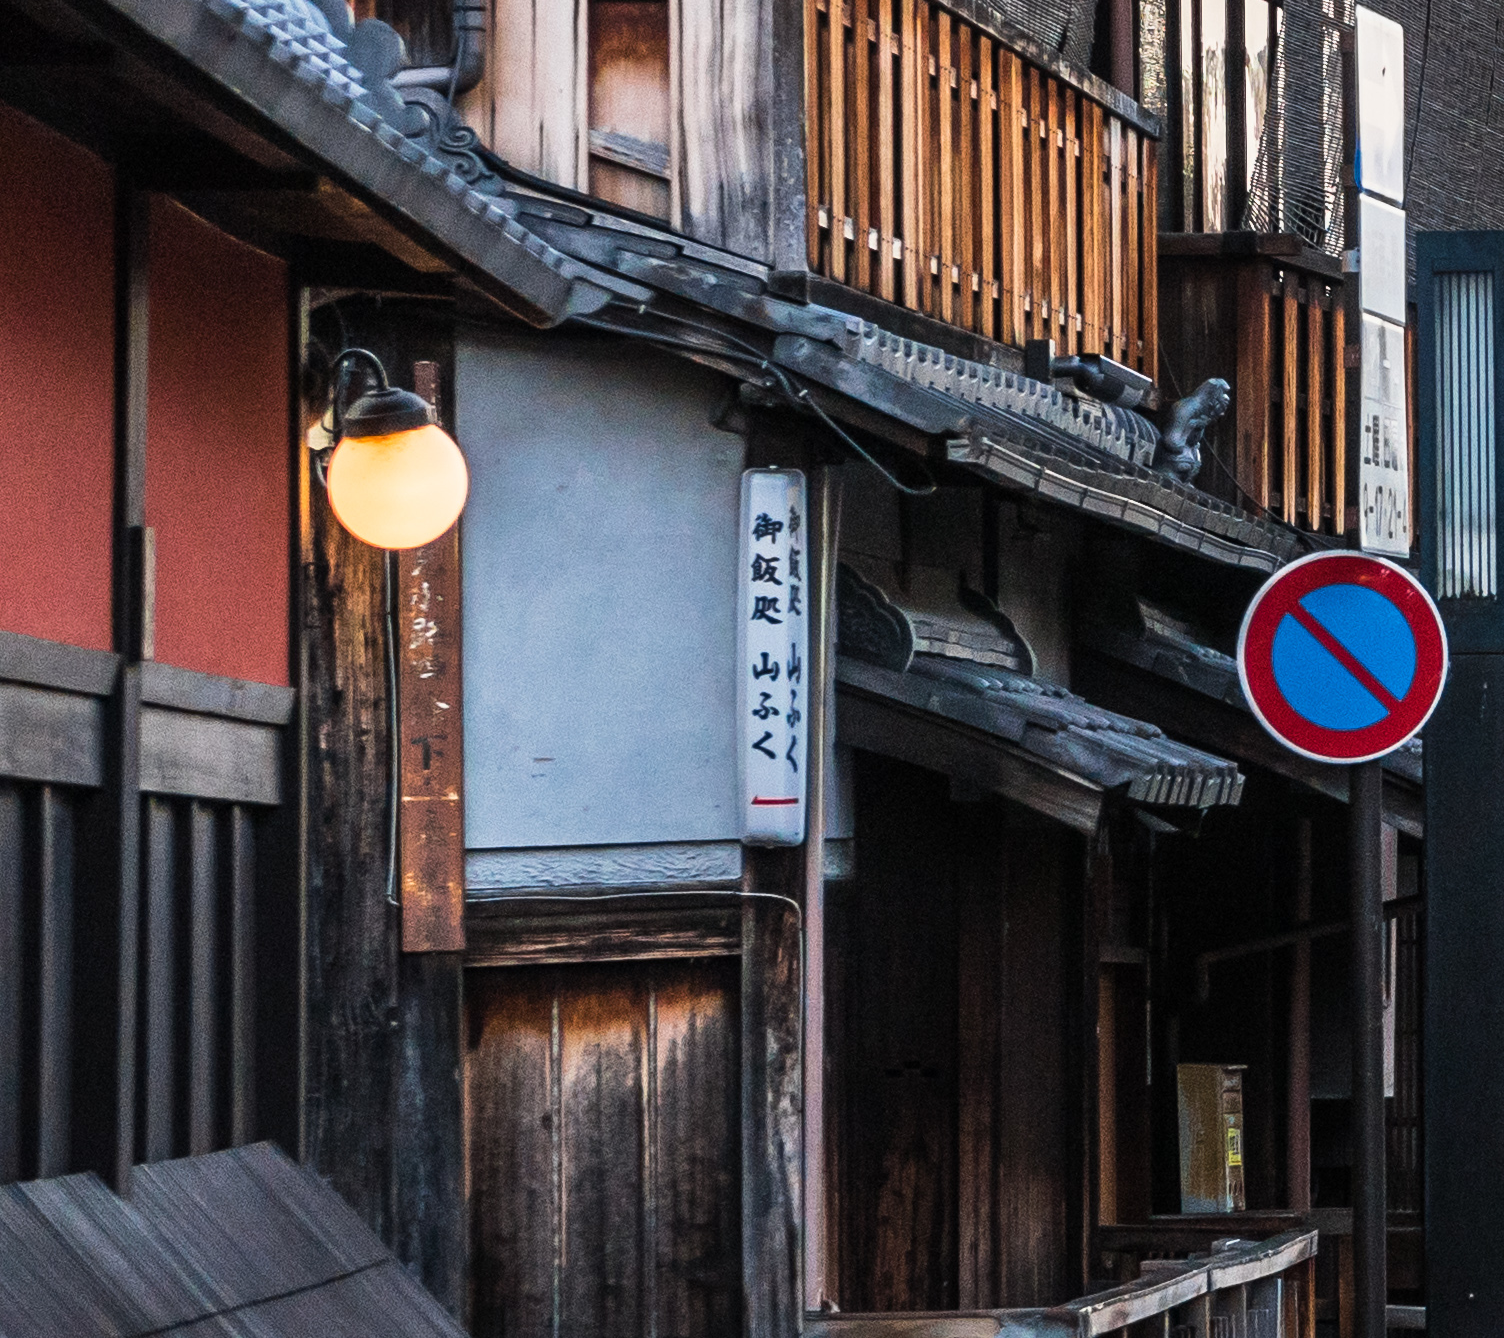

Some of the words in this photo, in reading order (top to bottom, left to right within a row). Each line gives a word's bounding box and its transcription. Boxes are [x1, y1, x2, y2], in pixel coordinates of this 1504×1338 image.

[750, 511, 784, 626] 御飯処
[751, 651, 781, 760] 山ふく
